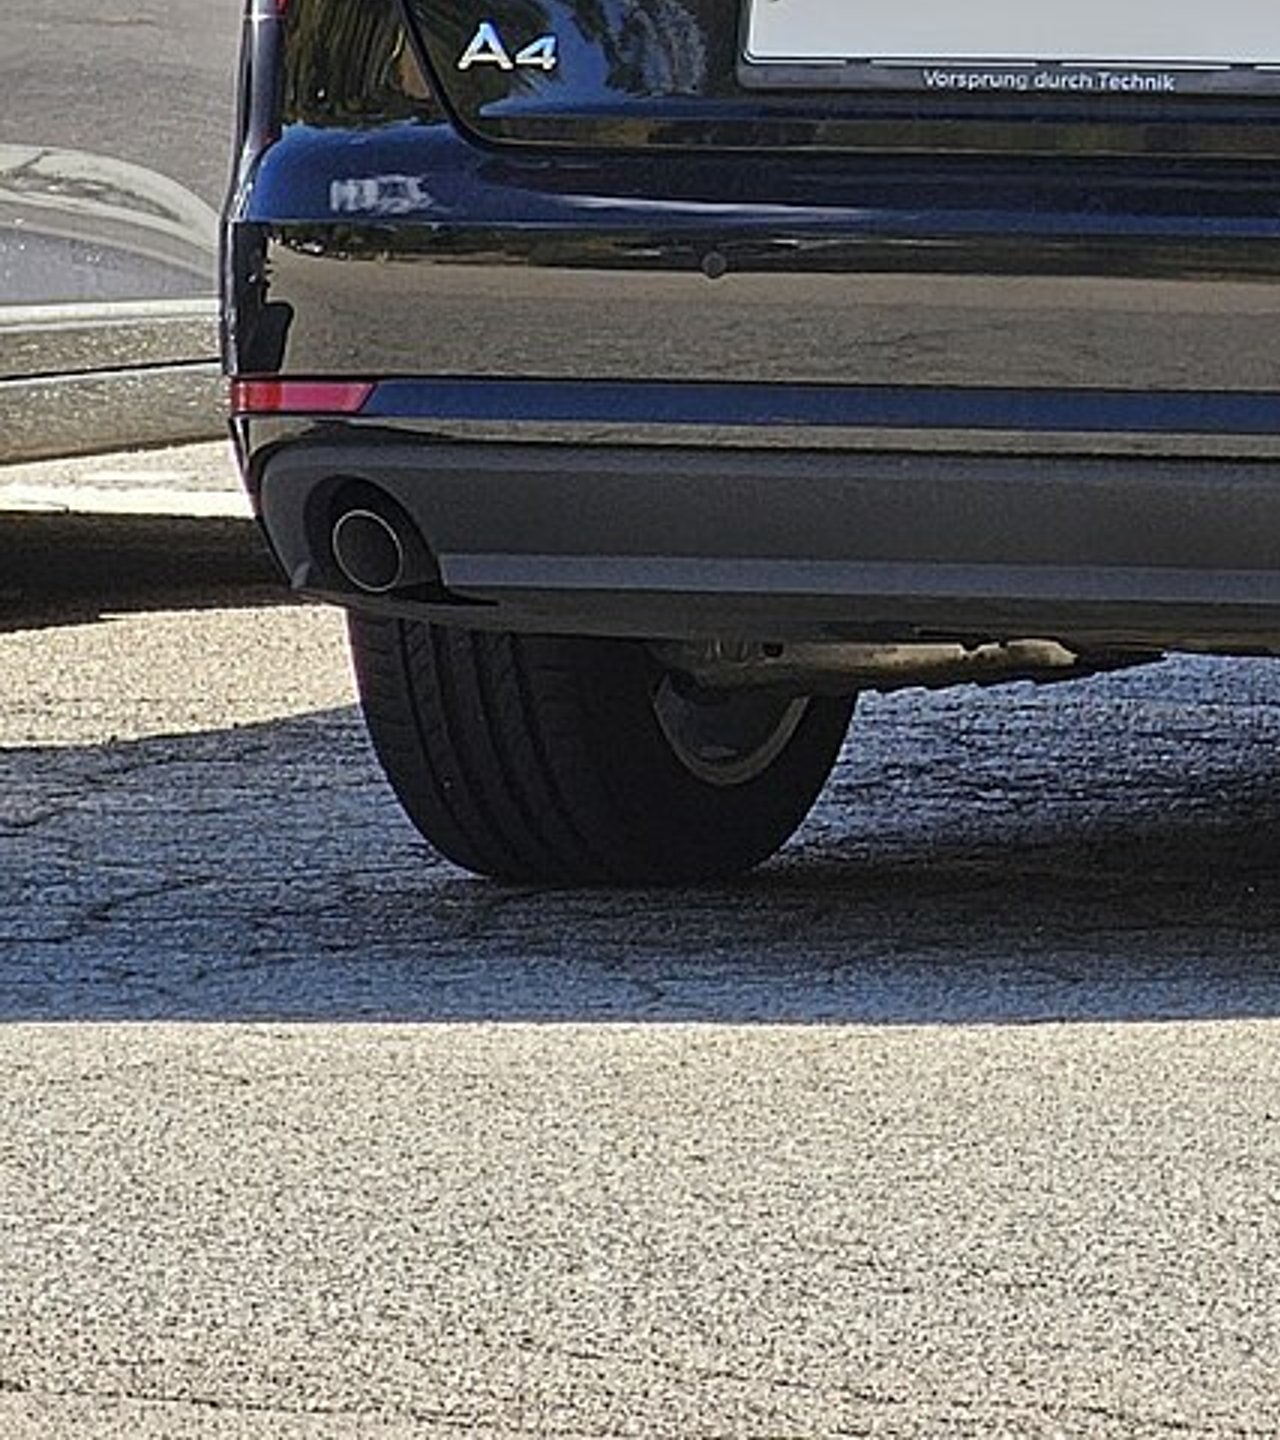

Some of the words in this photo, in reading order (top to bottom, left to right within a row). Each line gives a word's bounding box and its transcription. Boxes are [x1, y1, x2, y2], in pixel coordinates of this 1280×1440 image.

[458, 23, 557, 70] A4
[923, 69, 1029, 91] Vorsprung
[1034, 70, 1094, 89] durch
[1098, 71, 1175, 91] Technik
